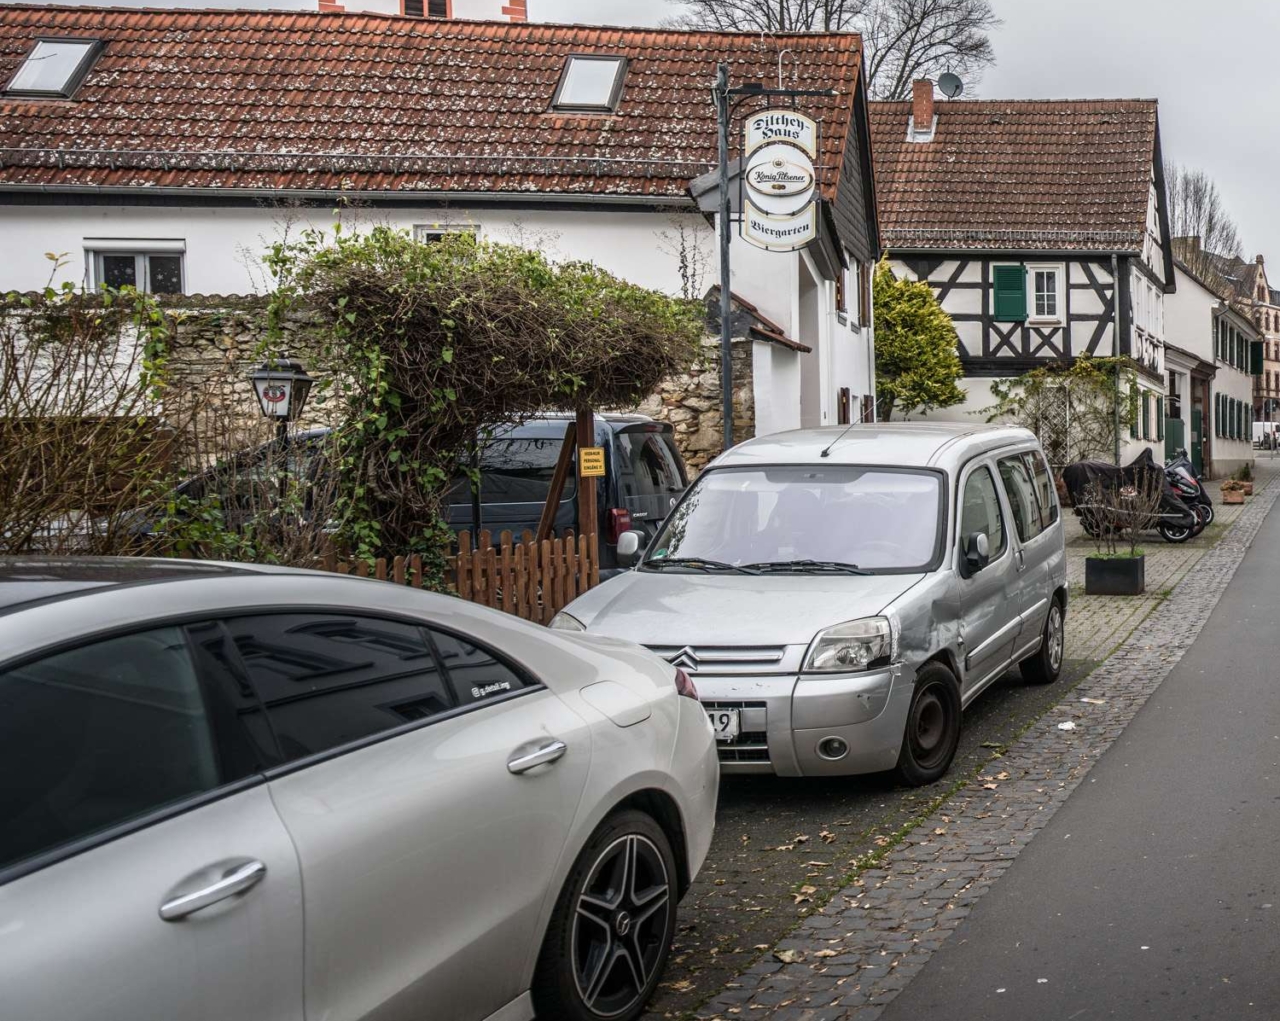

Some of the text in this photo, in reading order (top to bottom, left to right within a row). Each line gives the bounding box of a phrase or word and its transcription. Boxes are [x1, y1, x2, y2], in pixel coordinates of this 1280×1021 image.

[762, 127, 800, 140] Haus
[754, 171, 806, 181] König Pilsener
[751, 220, 809, 238] Biergarten
